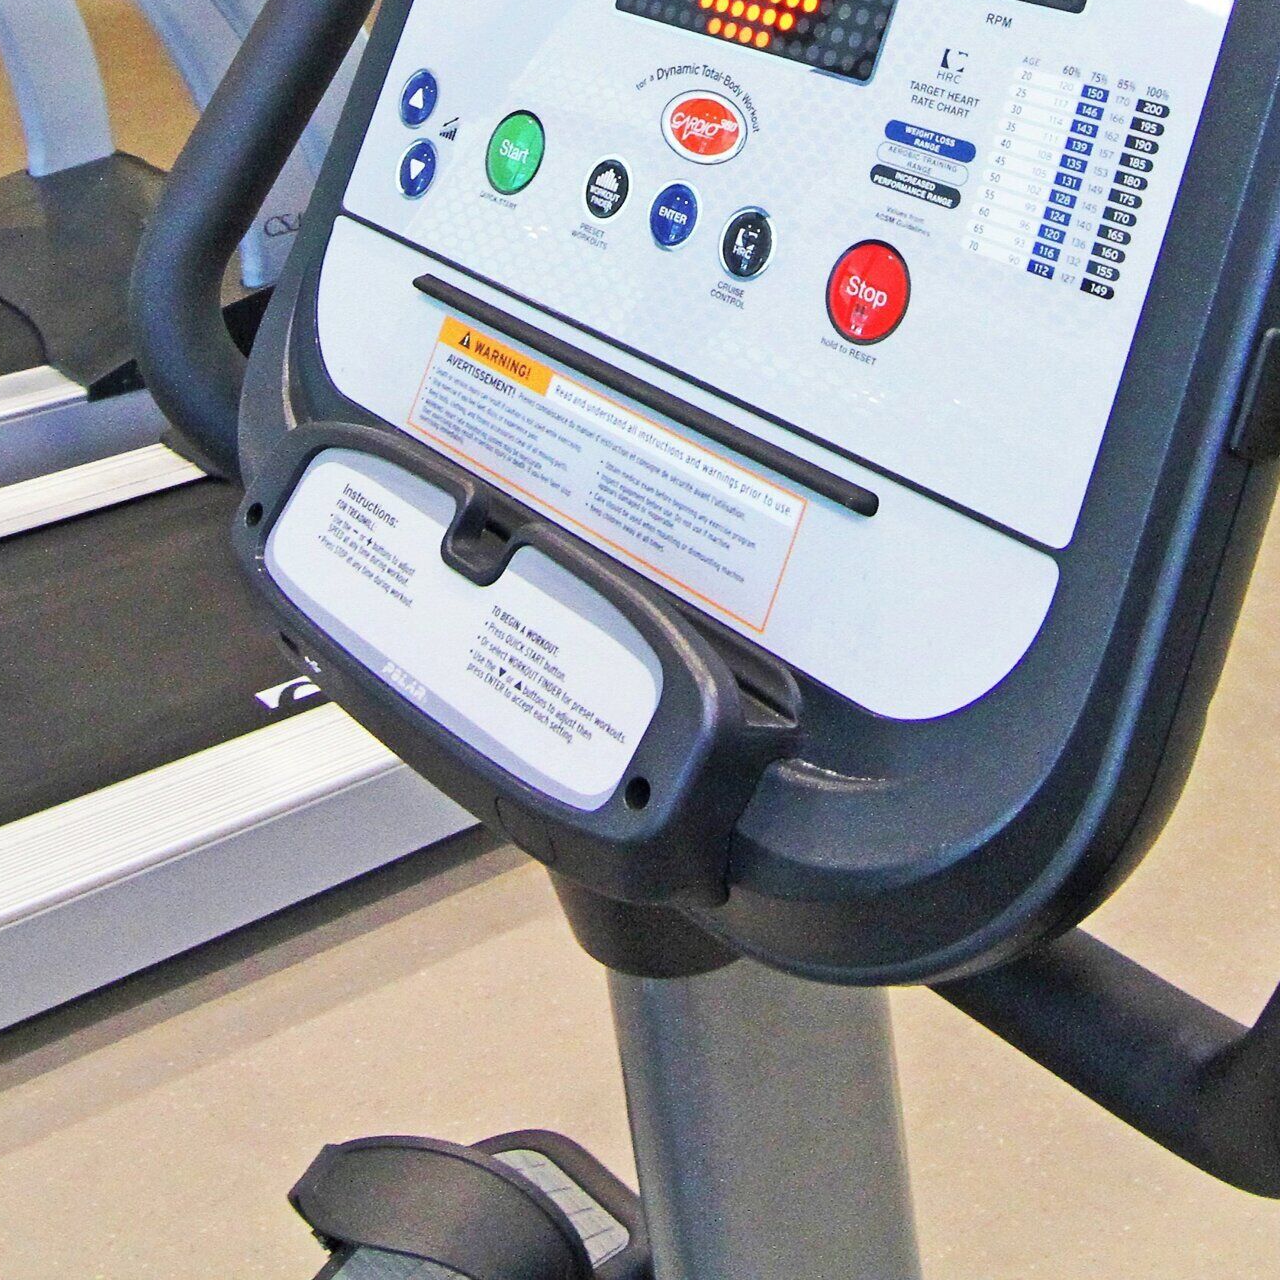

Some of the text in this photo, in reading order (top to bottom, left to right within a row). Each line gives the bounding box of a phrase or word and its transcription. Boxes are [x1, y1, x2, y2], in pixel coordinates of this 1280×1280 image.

[986, 13, 1013, 28] RPM
[910, 80, 980, 108] TARGET HEART
[936, 70, 962, 85] HRC
[1021, 70, 1163, 115] 20 150 200
[1022, 56, 1170, 100] AGE 60% 75% 85% 100%
[636, 78, 647, 90] for
[657, 63, 700, 80] Dynamic
[702, 64, 744, 98] Total-Body
[742, 93, 760, 133] Workout
[910, 94, 970, 118] RATE CHART
[1016, 87, 1157, 134] 25 146 195
[671, 112, 720, 140] CARDIO
[905, 125, 956, 147] WEIGHT LOSS
[1010, 104, 1152, 151] 30 143 190
[500, 139, 529, 164] Start
[914, 138, 941, 153] RANGE
[1006, 121, 1146, 169] 35 139 185
[906, 162, 932, 175] RANGE
[922, 154, 958, 173] TRAINING
[1000, 139, 1141, 187] 40 135 180
[589, 185, 620, 202] WORKOUT
[874, 174, 953, 208] PERFORMANCE RANGE
[895, 172, 936, 191] INCREASED
[995, 155, 1135, 206] 45 131 175
[990, 172, 1130, 224] 50 128 170
[580, 223, 605, 238] PRESET
[658, 206, 688, 225] ENTER
[985, 189, 1124, 242] 55 124 165
[571, 230, 608, 250] WORKOUTS
[979, 206, 1119, 260] 60 120 160
[732, 245, 752, 260] HRC
[973, 223, 1113, 278] 65 116 155
[968, 240, 1108, 296] 70 112 149
[710, 289, 745, 310] CONTROL
[717, 280, 745, 298] CRUISE
[846, 275, 888, 309] Stop
[474, 340, 532, 380] WARNING!
[820, 336, 877, 366] hold to RESET
[446, 354, 516, 398] AVERTISSEMENT!
[555, 384, 573, 401] Read
[572, 397, 586, 409] and
[587, 403, 629, 430] understand
[628, 424, 638, 435] all
[638, 429, 684, 460] instructions
[685, 456, 701, 470] and
[702, 465, 739, 490] warnings
[740, 484, 762, 500] prior
[764, 494, 773, 506] to
[342, 483, 399, 528] Instructions:
[492, 605, 501, 617] TO
[500, 612, 521, 630] BEGIN
[520, 626, 527, 635] A
[488, 622, 505, 640] Press
[505, 634, 525, 653] QUICK
[525, 647, 545, 666] START
[467, 662, 484, 680] press
[484, 673, 505, 693] ENTER
[504, 688, 512, 699] to
[511, 694, 534, 714] accept
[533, 709, 550, 726] each
[472, 650, 485, 664] Use
[484, 659, 497, 671] the
[522, 685, 548, 709] buttons
[547, 704, 556, 715] to
[555, 710, 577, 730] adjust
[576, 722, 593, 741] then
[480, 636, 489, 647] Or
[489, 643, 508, 661] select
[508, 654, 539, 682] WORKOUT
[538, 675, 562, 699] FINDER
[561, 692, 572, 705] for
[570, 701, 595, 722] preset
